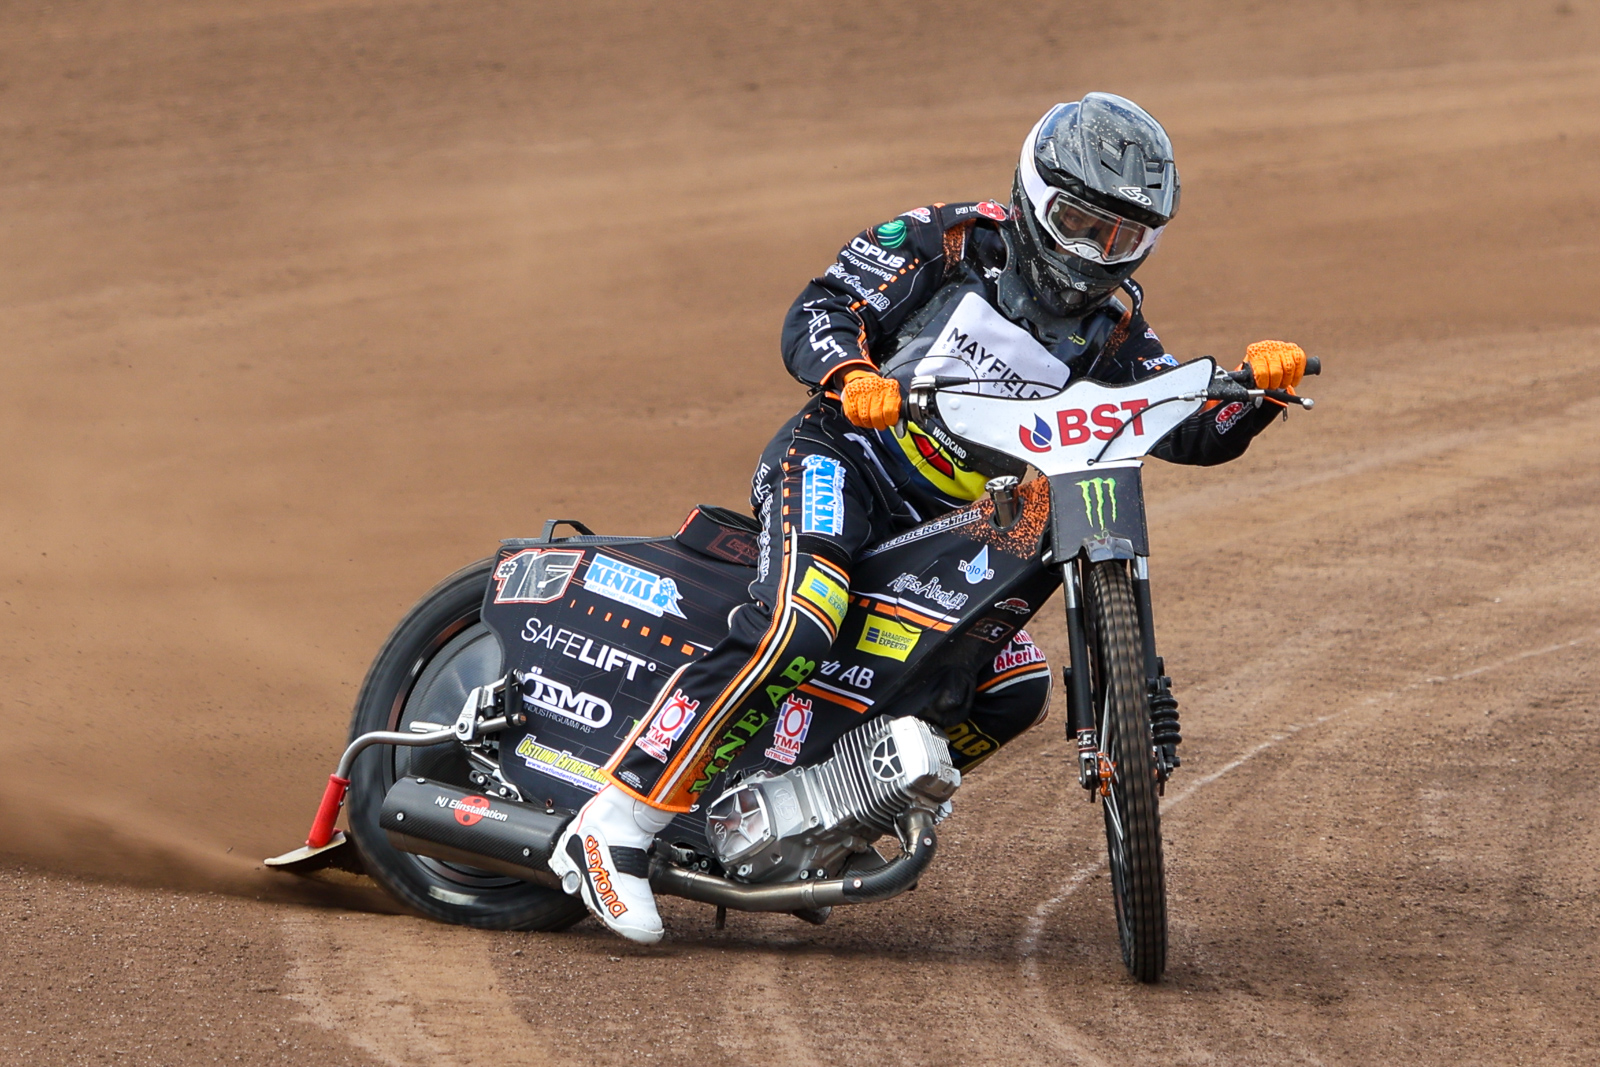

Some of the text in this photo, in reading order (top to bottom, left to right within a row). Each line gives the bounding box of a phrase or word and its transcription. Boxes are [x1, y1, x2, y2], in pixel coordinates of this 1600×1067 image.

[840, 250, 893, 282] Bilprovning
[850, 236, 906, 269] OPUS
[941, 342, 988, 379] SPRTS
[1056, 398, 1150, 447] BST
[932, 426, 968, 460] WILDCARD
[585, 563, 654, 601] KENTAS
[611, 562, 641, 577] TEAM
[980, 570, 994, 579] AB
[521, 617, 647, 682] SAFELIFT
[878, 637, 909, 651] EXPERTEN
[765, 655, 816, 709] AB
[839, 664, 876, 690] AB
[523, 666, 612, 729] ÖSMO
[579, 723, 592, 734] AB
[650, 724, 673, 750] TMA
[773, 733, 800, 752] TMA
[517, 735, 560, 765] ÖSTLUND
[526, 760, 602, 792] www.ostlundentreprenad.s
[434, 795, 509, 822] NJ Elinstallation
[583, 834, 629, 919] daytona
